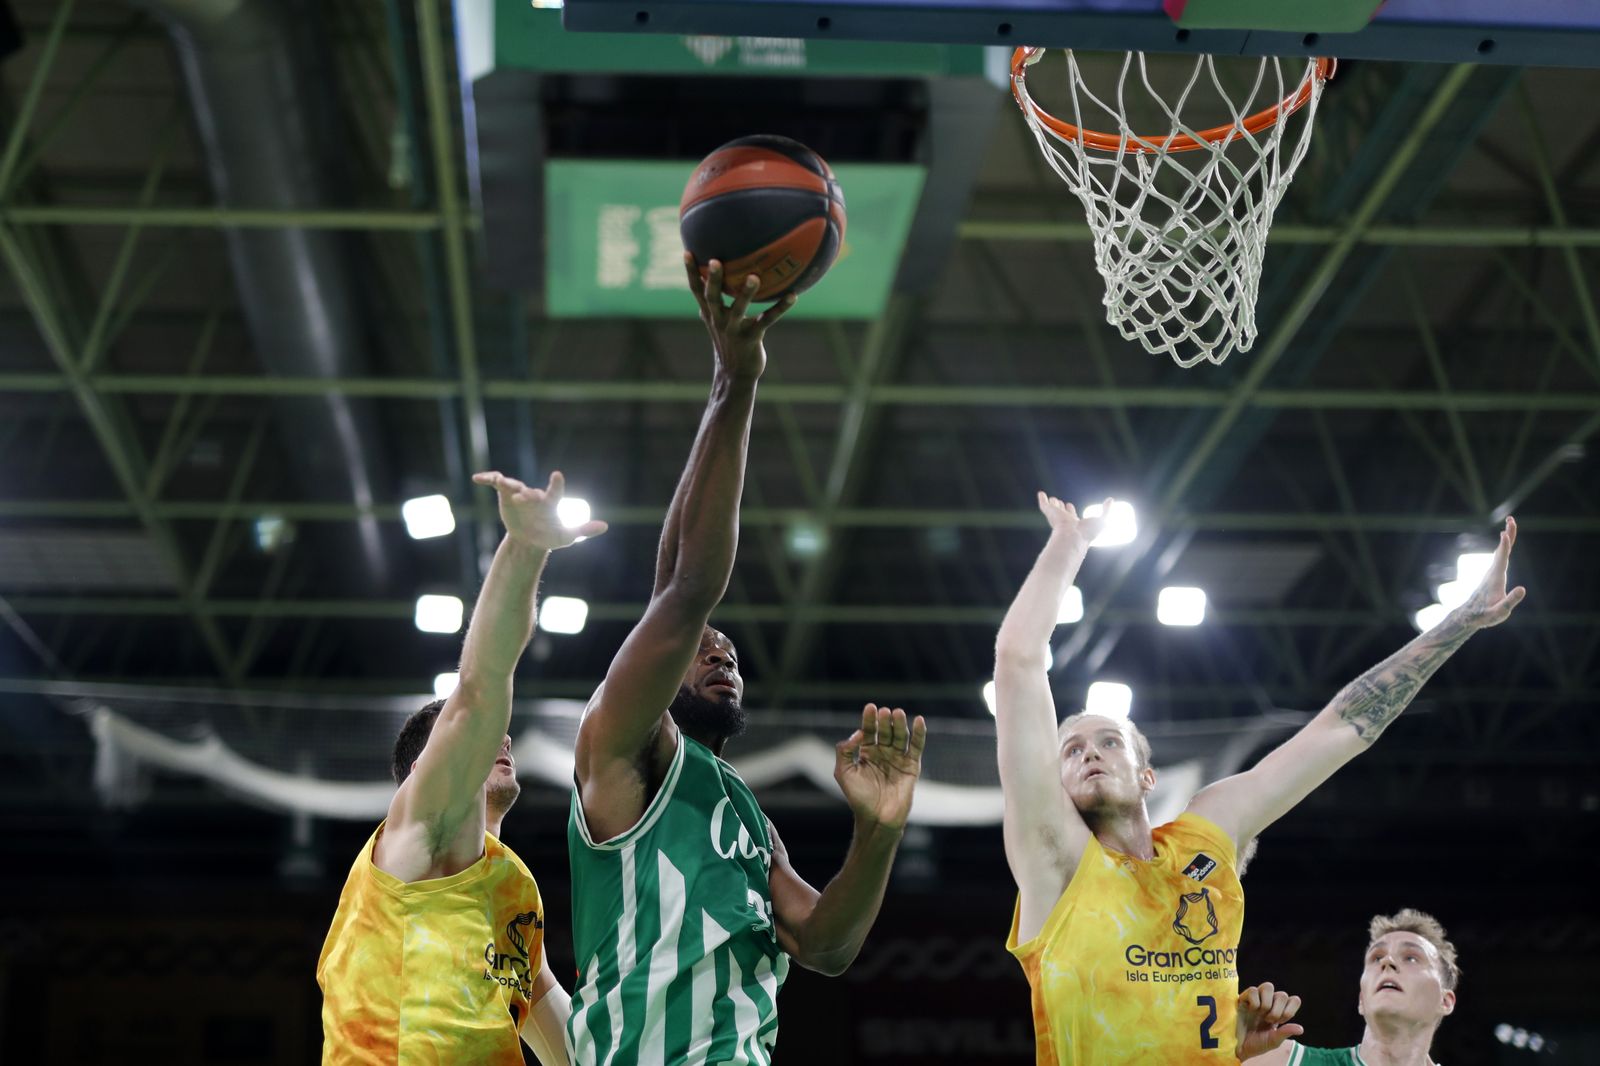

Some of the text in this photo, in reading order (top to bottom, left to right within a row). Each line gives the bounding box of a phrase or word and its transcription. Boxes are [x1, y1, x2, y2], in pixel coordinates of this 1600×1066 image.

[1126, 970, 1149, 982] Isla
[1152, 970, 1203, 985] Europea
[1204, 968, 1222, 981] del
[1196, 995, 1219, 1050] 2
